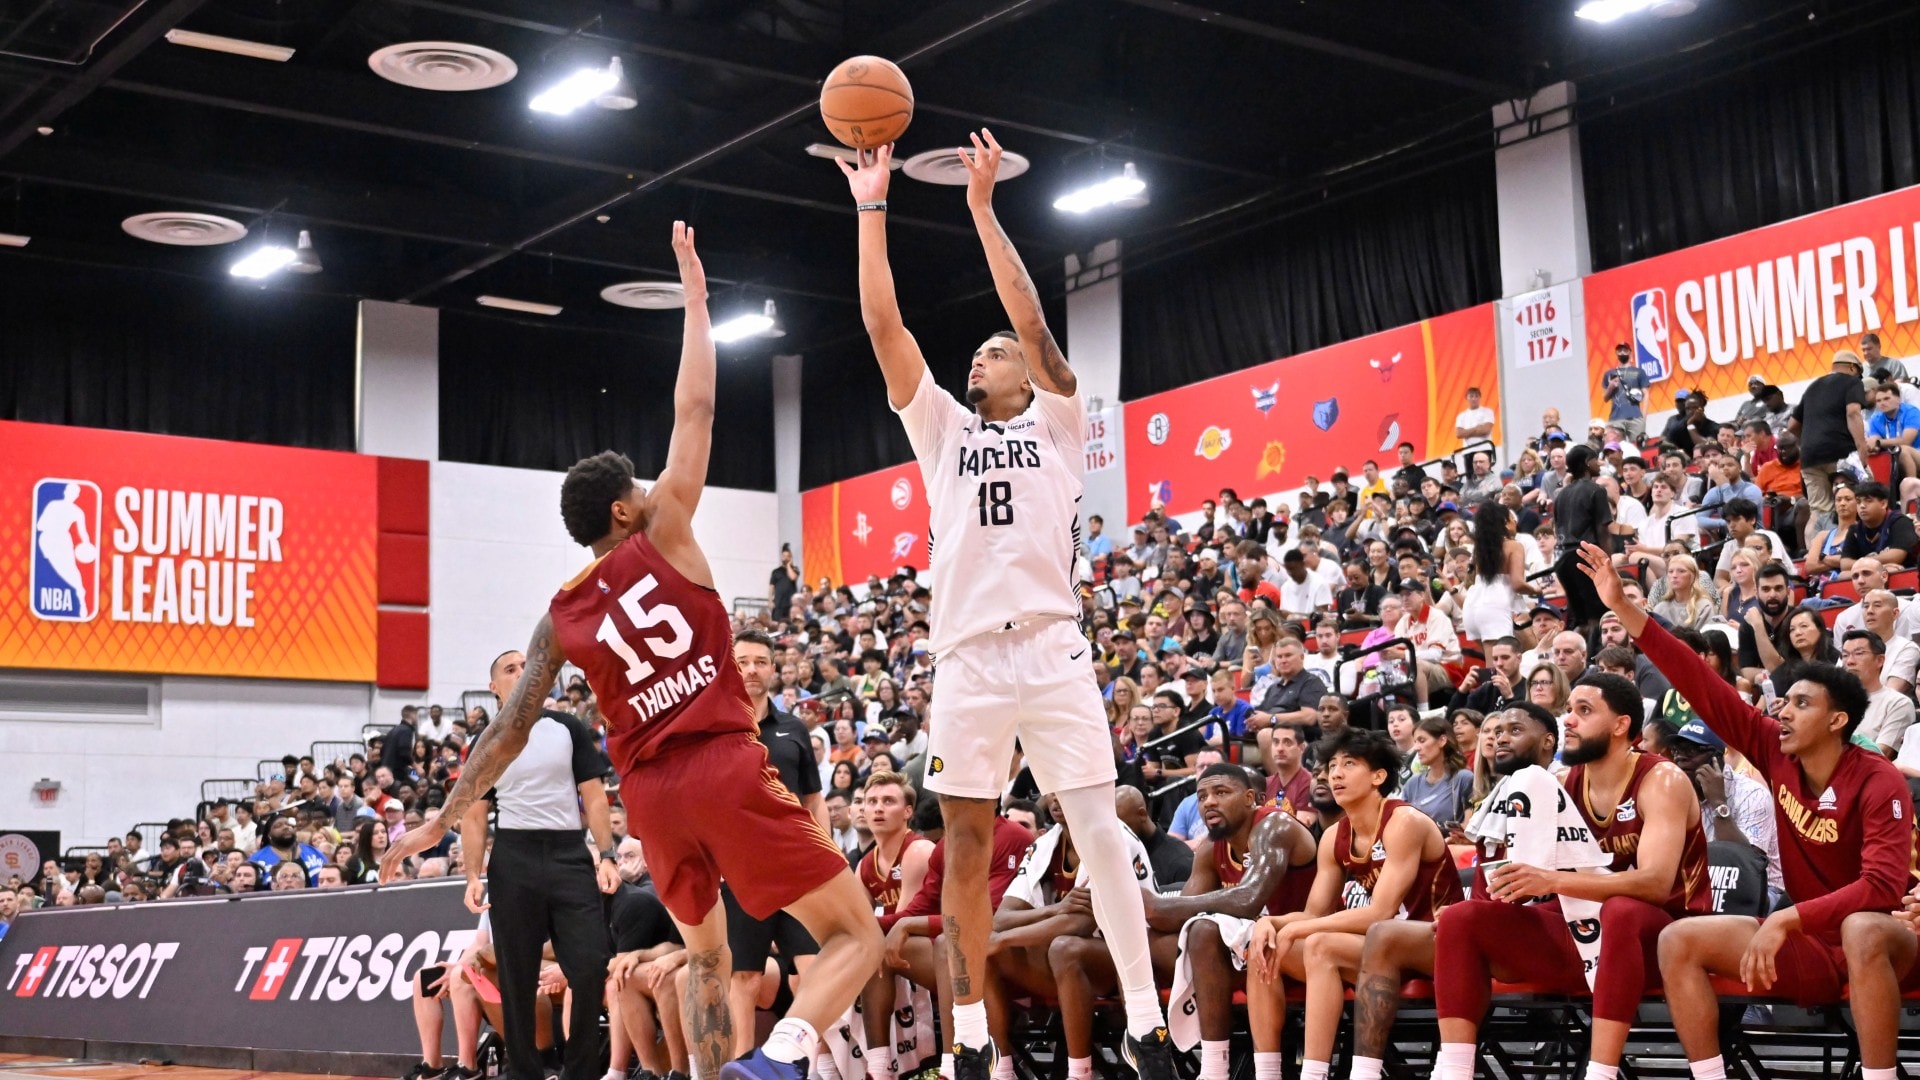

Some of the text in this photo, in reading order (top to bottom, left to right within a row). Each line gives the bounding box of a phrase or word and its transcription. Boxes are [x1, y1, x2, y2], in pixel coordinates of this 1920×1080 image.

[1526, 300, 1556, 326] 116
[1674, 236, 1882, 373] SUMMER
[1527, 335, 1557, 361] 117
[1530, 327, 1554, 339] SECTION
[1007, 423, 1025, 431] LUCAS
[958, 440, 1041, 477] PACERS
[1085, 450, 1106, 471] 116
[113, 487, 284, 562] SUMMER
[977, 481, 1014, 527] 18
[40, 587, 73, 612] NBA
[111, 555, 257, 628] LEAGUE
[595, 573, 694, 686] 15
[627, 654, 718, 723] THOMAS
[42, 942, 181, 999] TISSOT
[289, 930, 478, 1002] TISSOT
